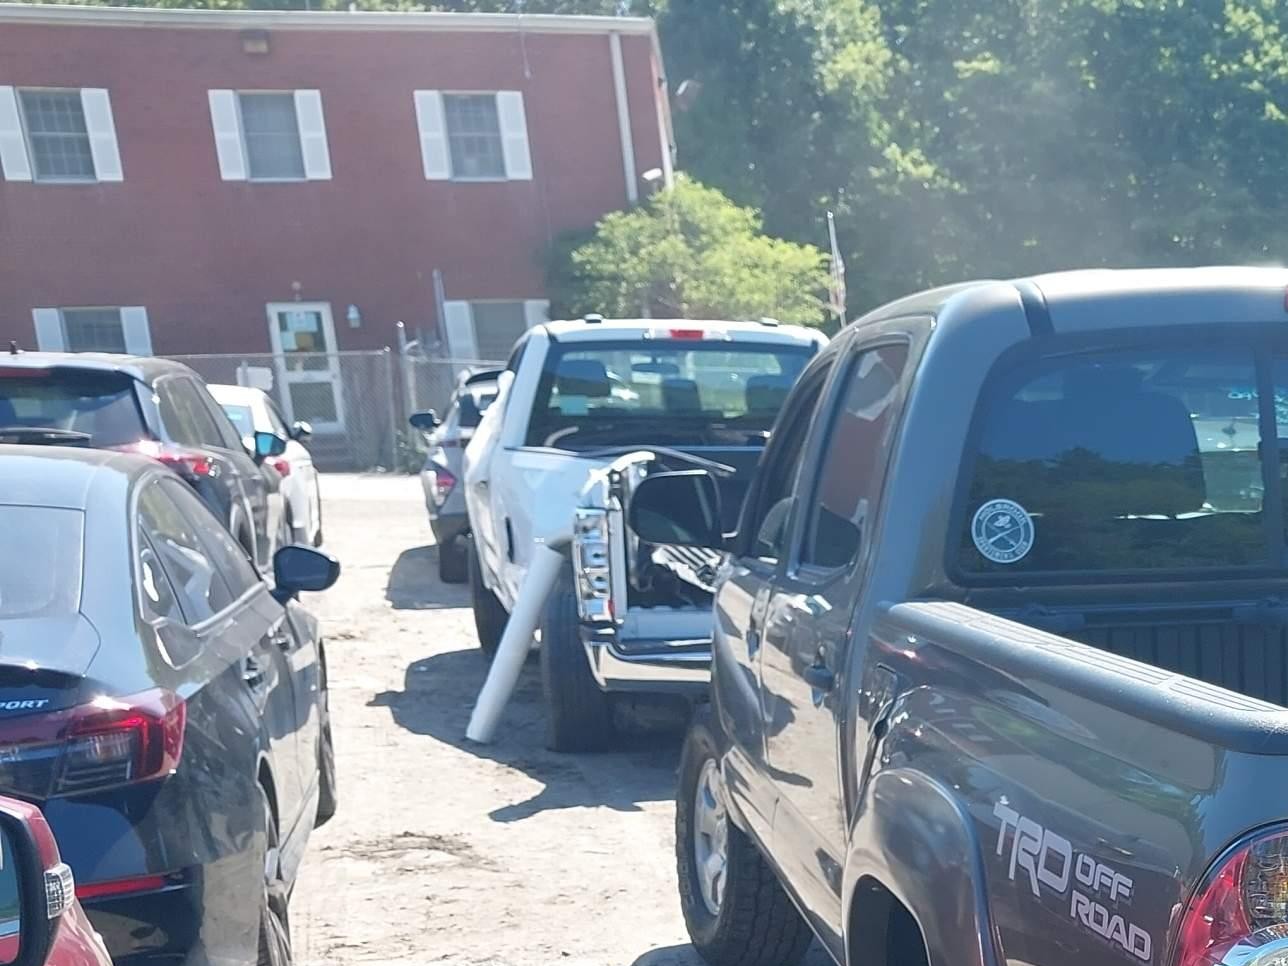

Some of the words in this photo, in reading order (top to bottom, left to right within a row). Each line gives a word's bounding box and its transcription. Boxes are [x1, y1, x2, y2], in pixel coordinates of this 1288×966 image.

[993, 801, 1073, 897] TRD
[1075, 853, 1133, 901] OFF
[1070, 889, 1152, 961] ROAD
